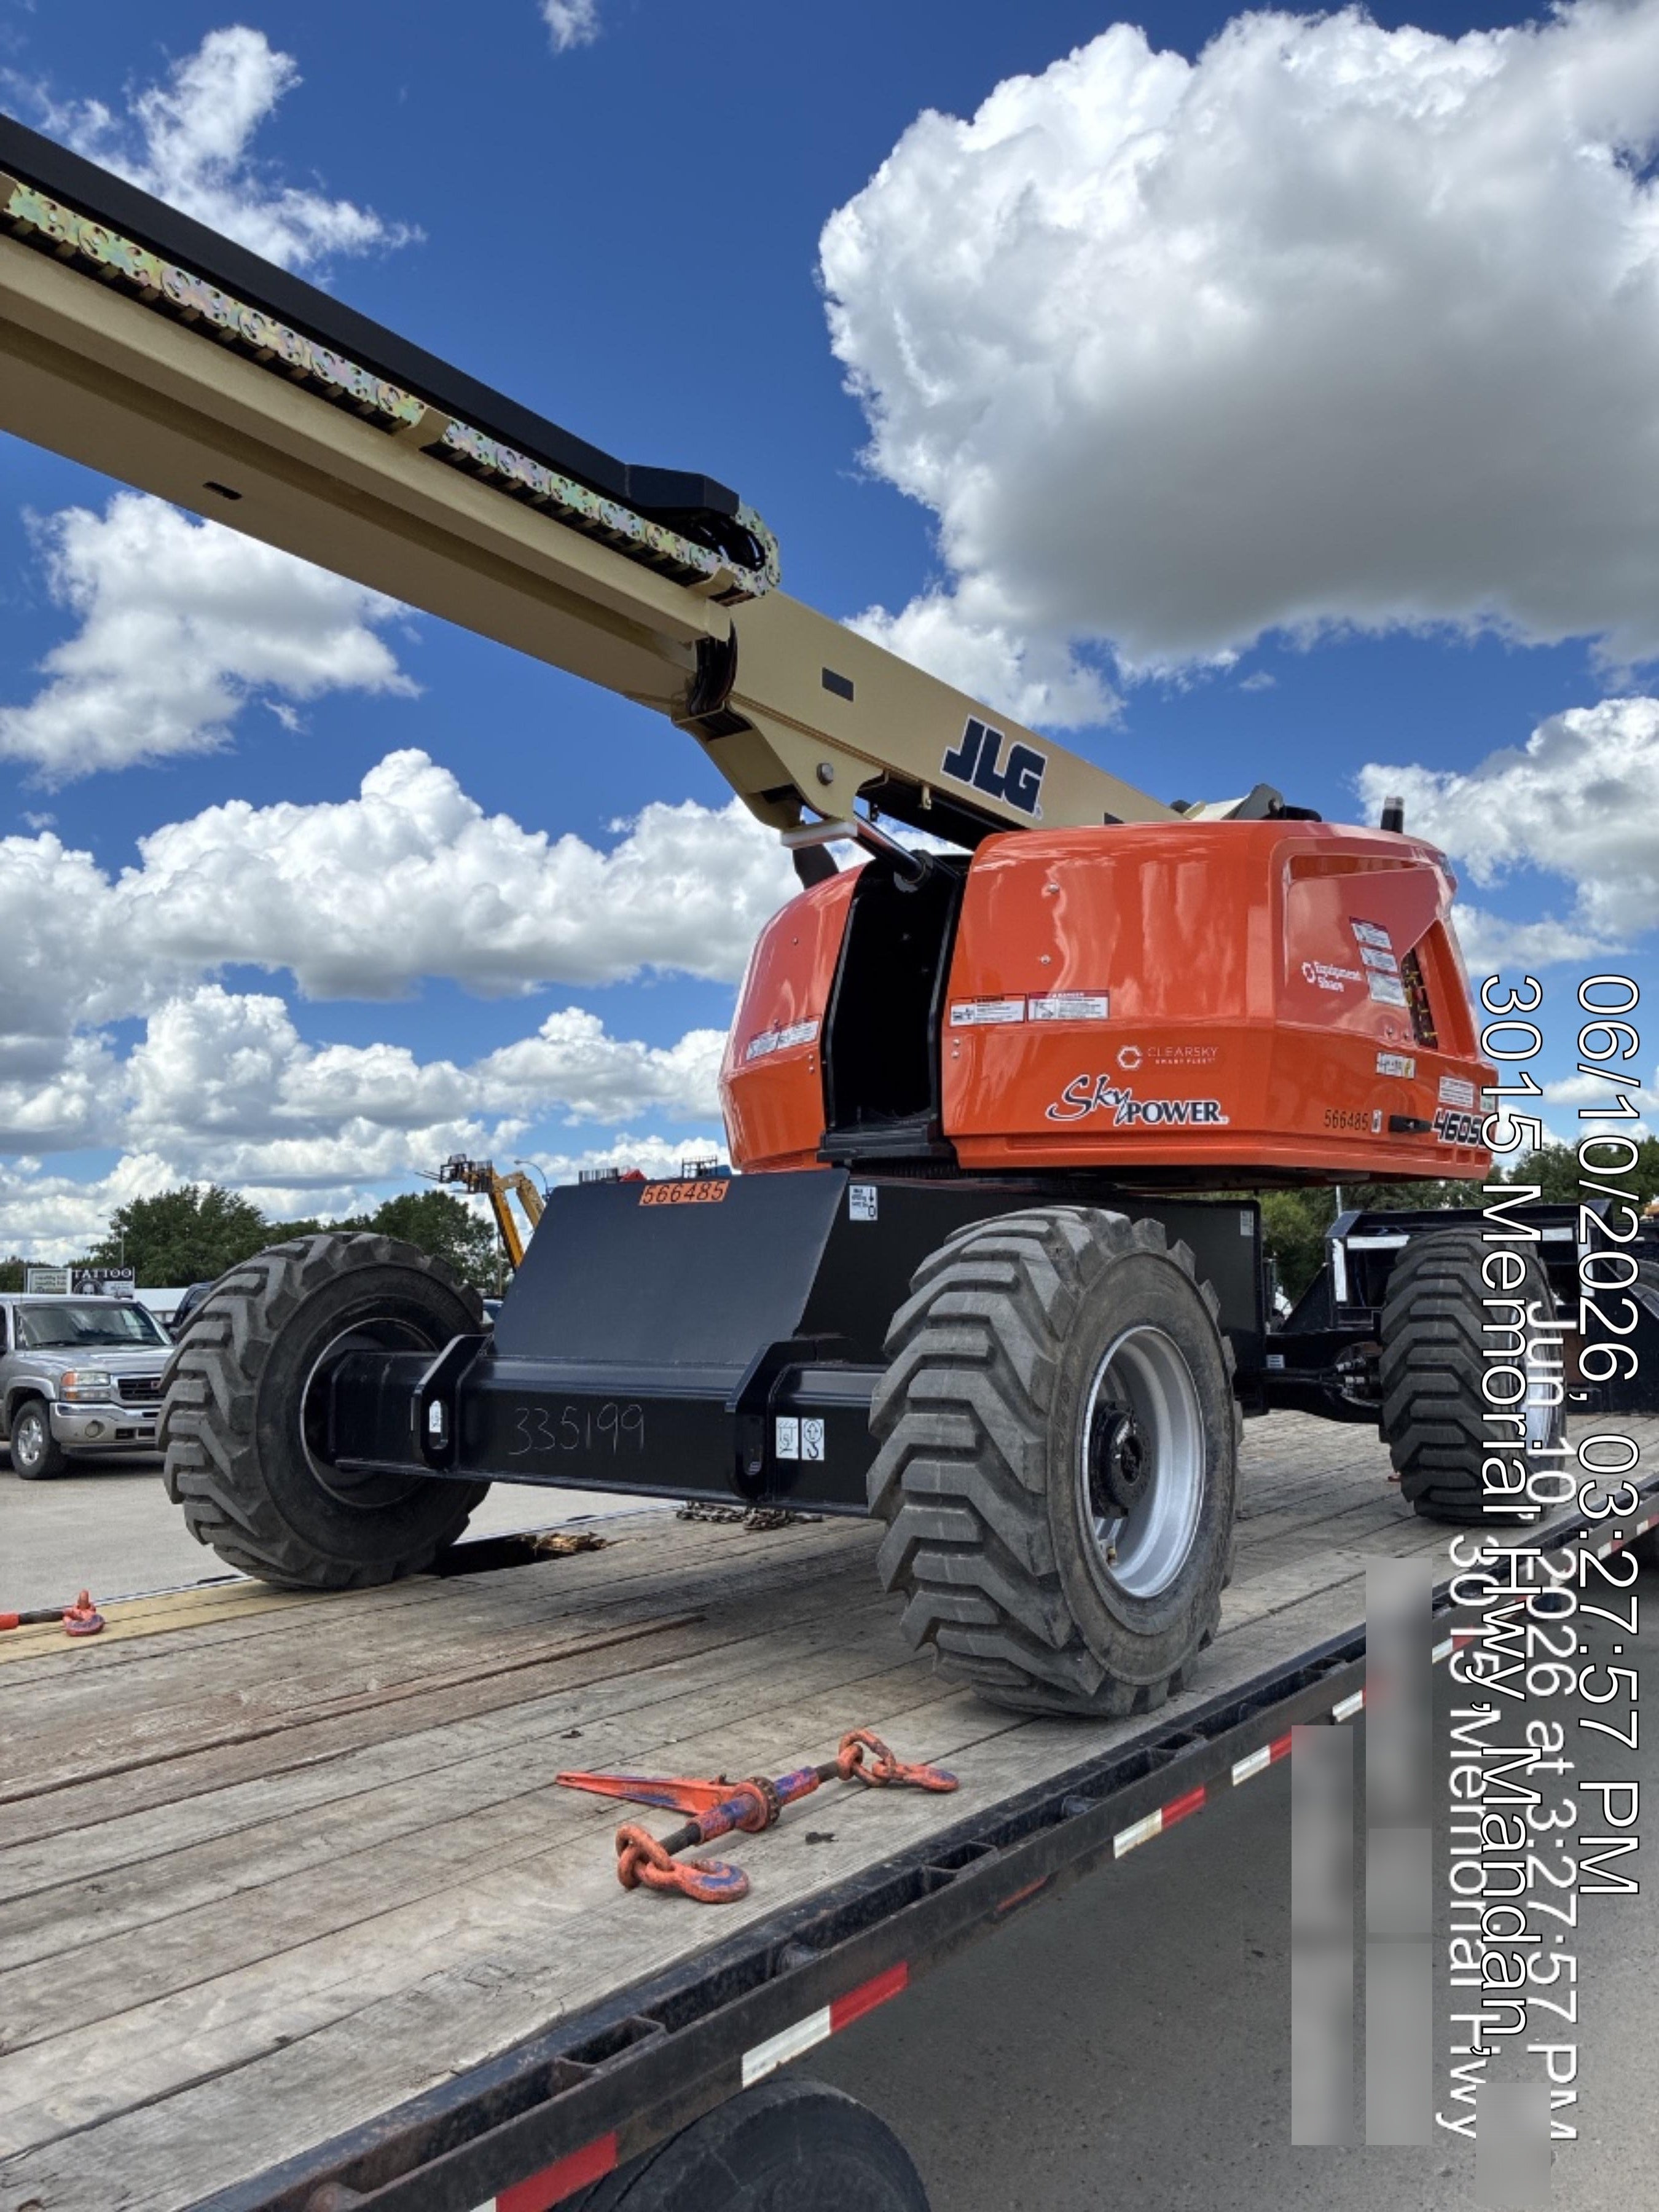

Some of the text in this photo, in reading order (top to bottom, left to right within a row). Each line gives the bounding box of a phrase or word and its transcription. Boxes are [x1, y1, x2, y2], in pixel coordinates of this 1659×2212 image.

[940, 714, 1048, 818] JLG
[1147, 1046, 1219, 1057] CLEARSKY
[1324, 1108, 1368, 1131] 566485
[1432, 1107, 1487, 1148] 460S
[643, 1180, 725, 1204] 566485
[73, 1269, 131, 1279] TATTOO
[508, 1403, 645, 1455] 335199
